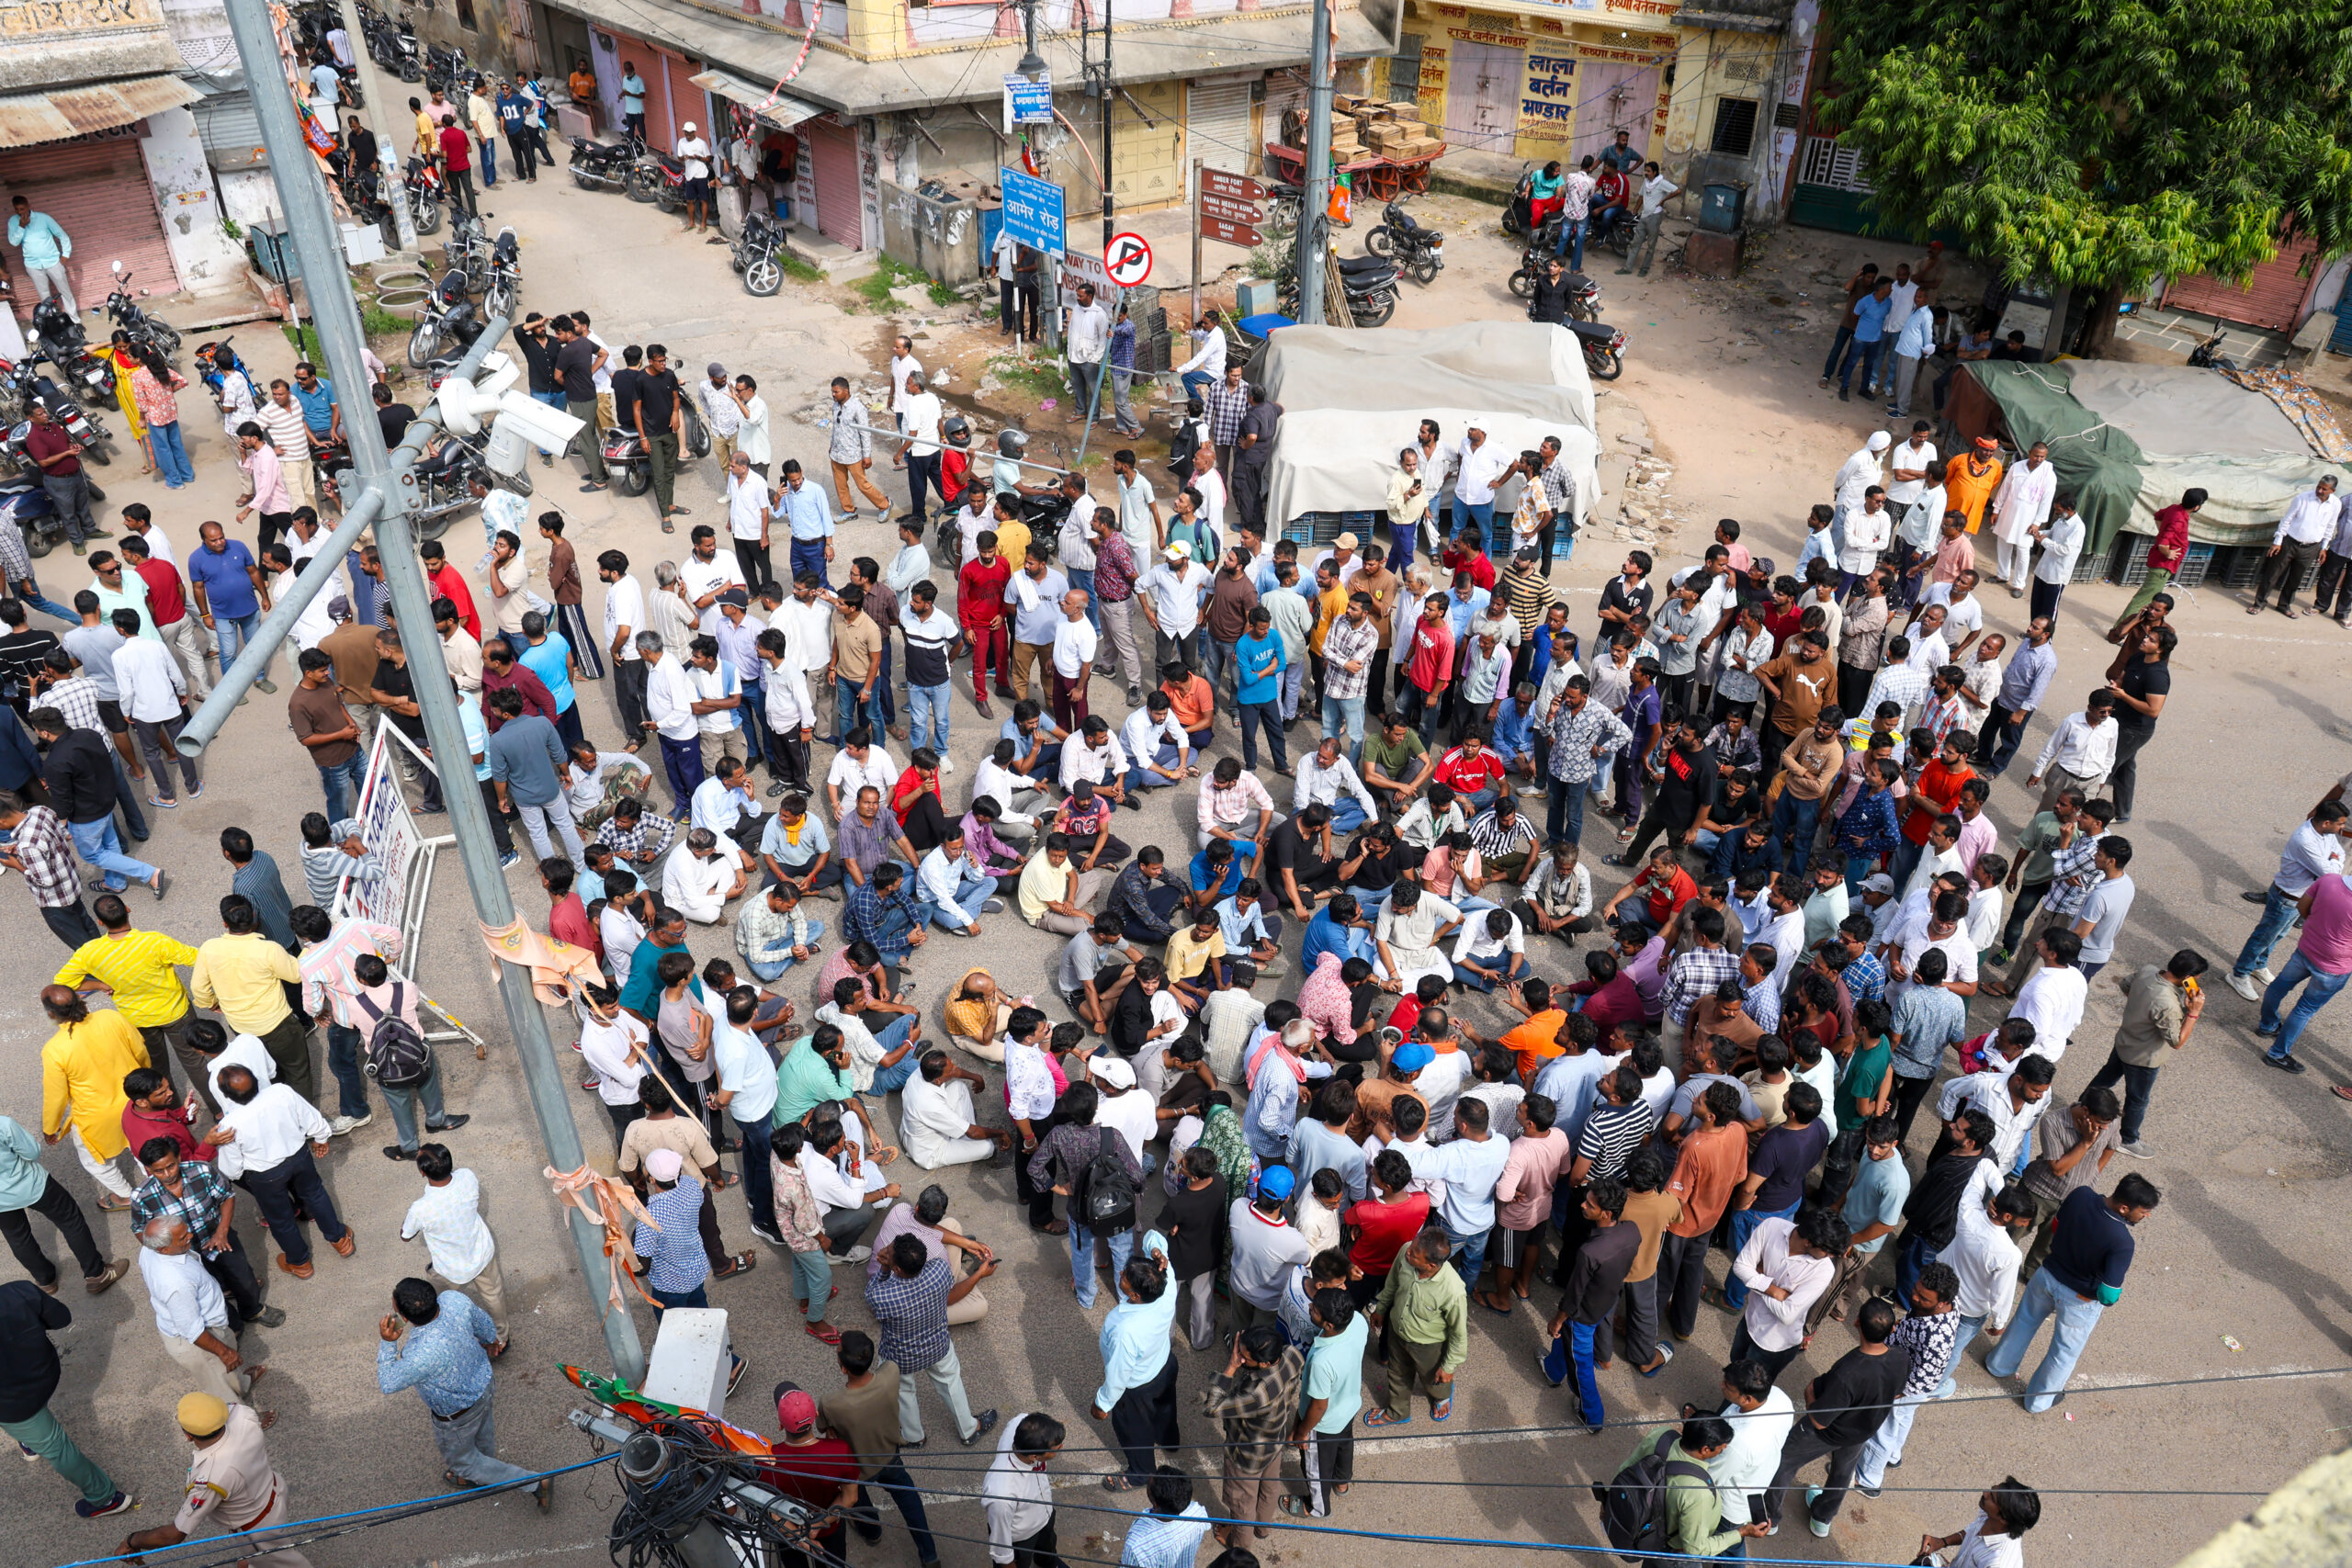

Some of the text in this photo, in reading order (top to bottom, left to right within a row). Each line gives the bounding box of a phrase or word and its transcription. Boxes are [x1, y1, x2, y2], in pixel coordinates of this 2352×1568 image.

[1657, 3, 1681, 16] भण्डा
[1421, 47, 1446, 60] लाला
[1421, 65, 1444, 82] बर्तन
[1528, 54, 1577, 76] लाला
[1529, 74, 1571, 98] बर्तन
[1522, 98, 1571, 122] भण्डार
[1213, 175, 1243, 186] AMBER FORT
[1214, 183, 1242, 195] आमेर किला
[1204, 196, 1253, 213] PANNA MEENA KUND
[1007, 198, 1035, 221] आमेर
[1039, 207, 1059, 232] रोड़
[1218, 222, 1235, 231] SAGAR
[1115, 241, 1144, 276] P
[1087, 260, 1102, 275] TO
[1668, 749, 1692, 781] MARVEL
